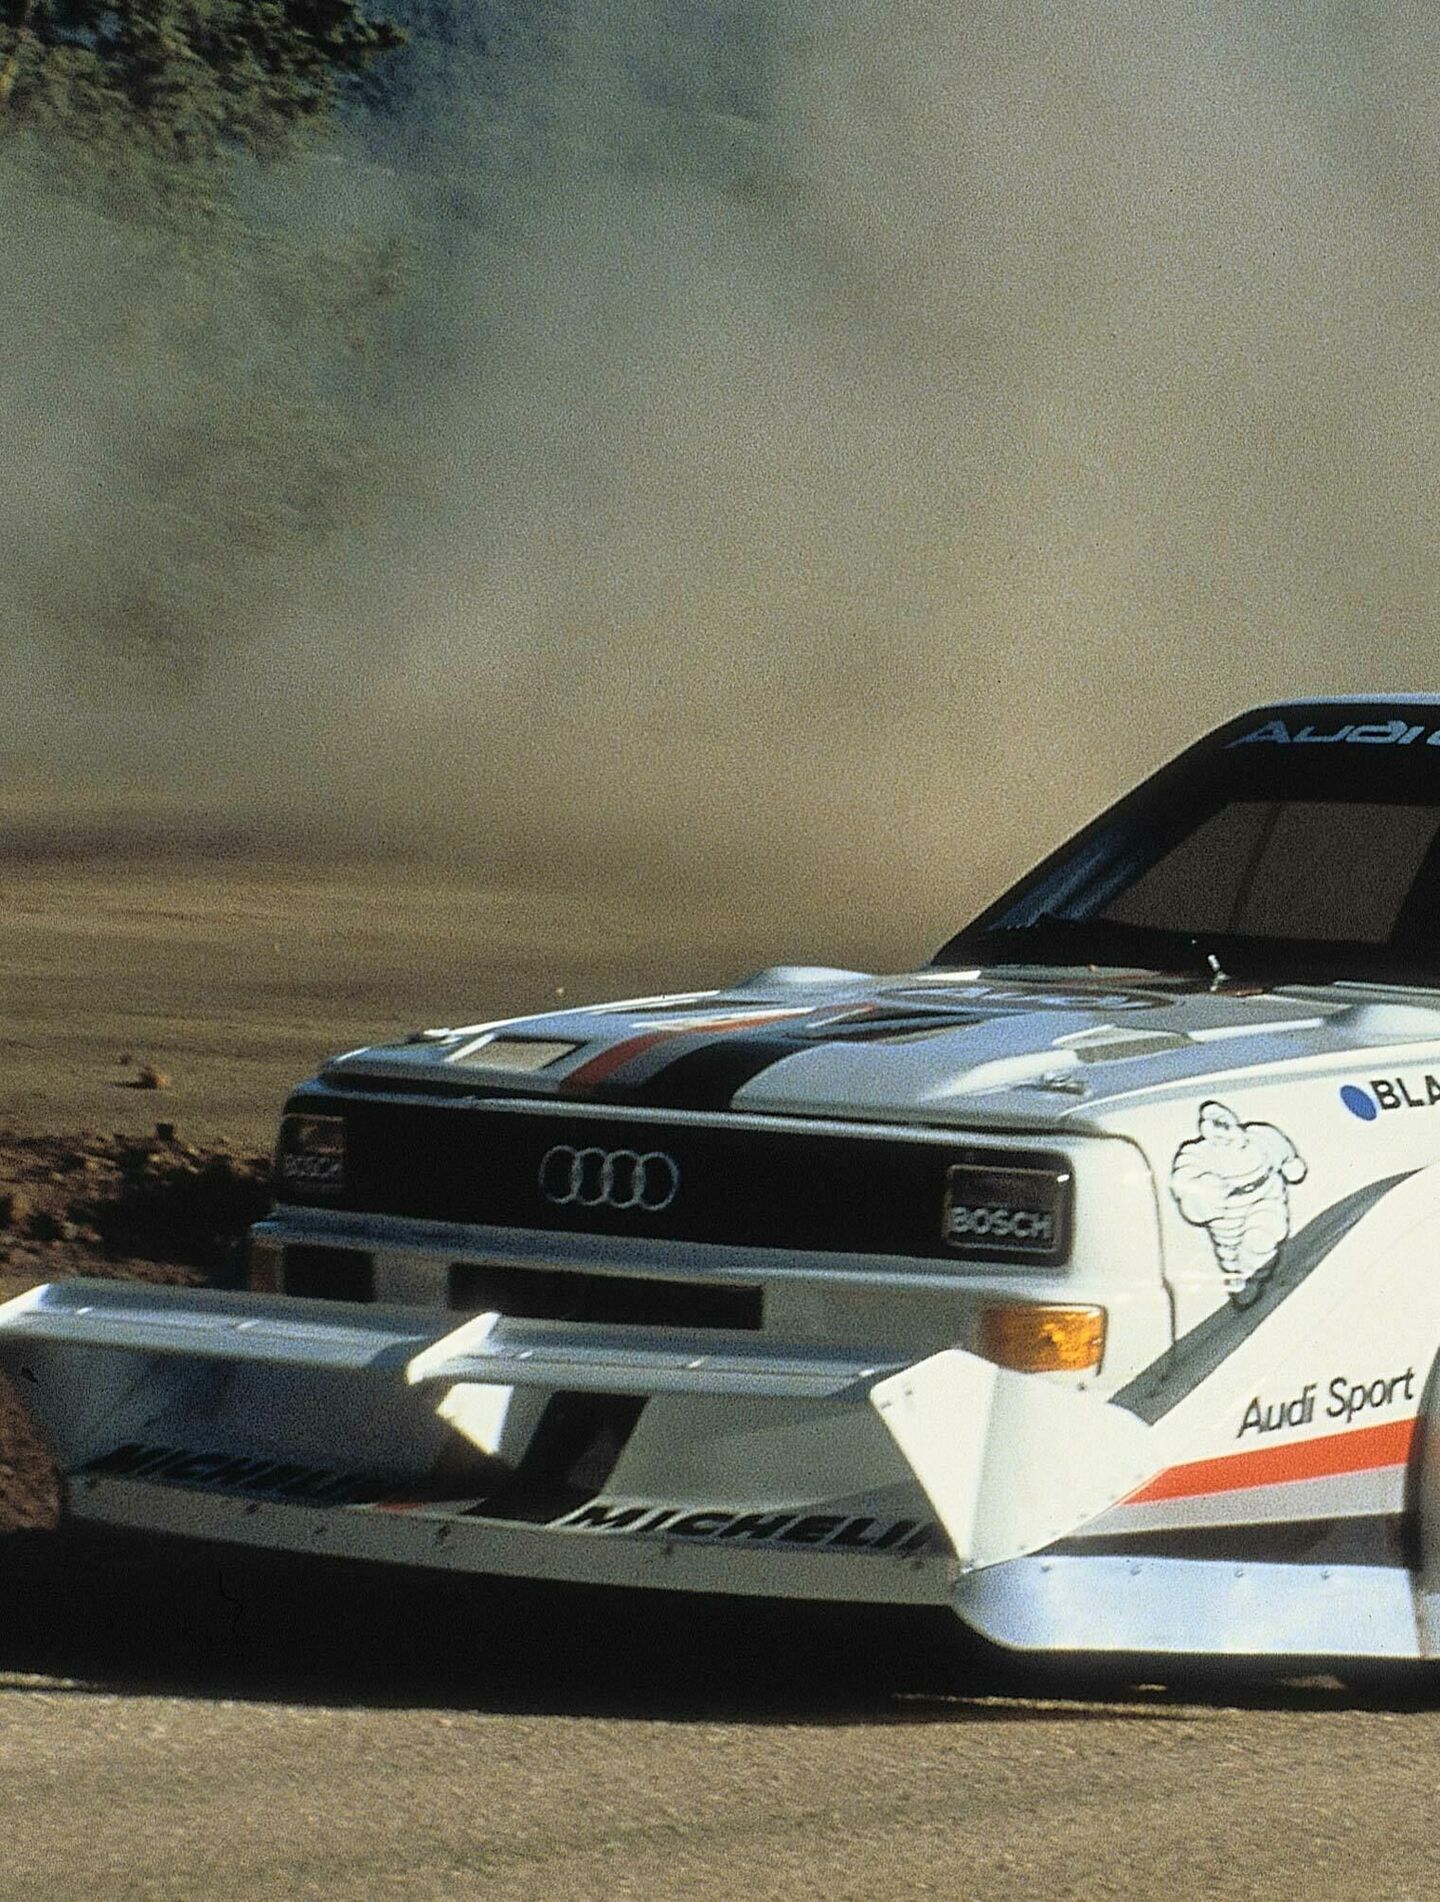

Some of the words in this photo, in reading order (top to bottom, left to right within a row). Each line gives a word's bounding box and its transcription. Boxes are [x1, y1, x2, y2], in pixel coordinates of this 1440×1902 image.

[952, 1206, 1053, 1239] BOSCH
[1236, 1382, 1318, 1439] Audi
[1326, 1366, 1415, 1423] Sport
